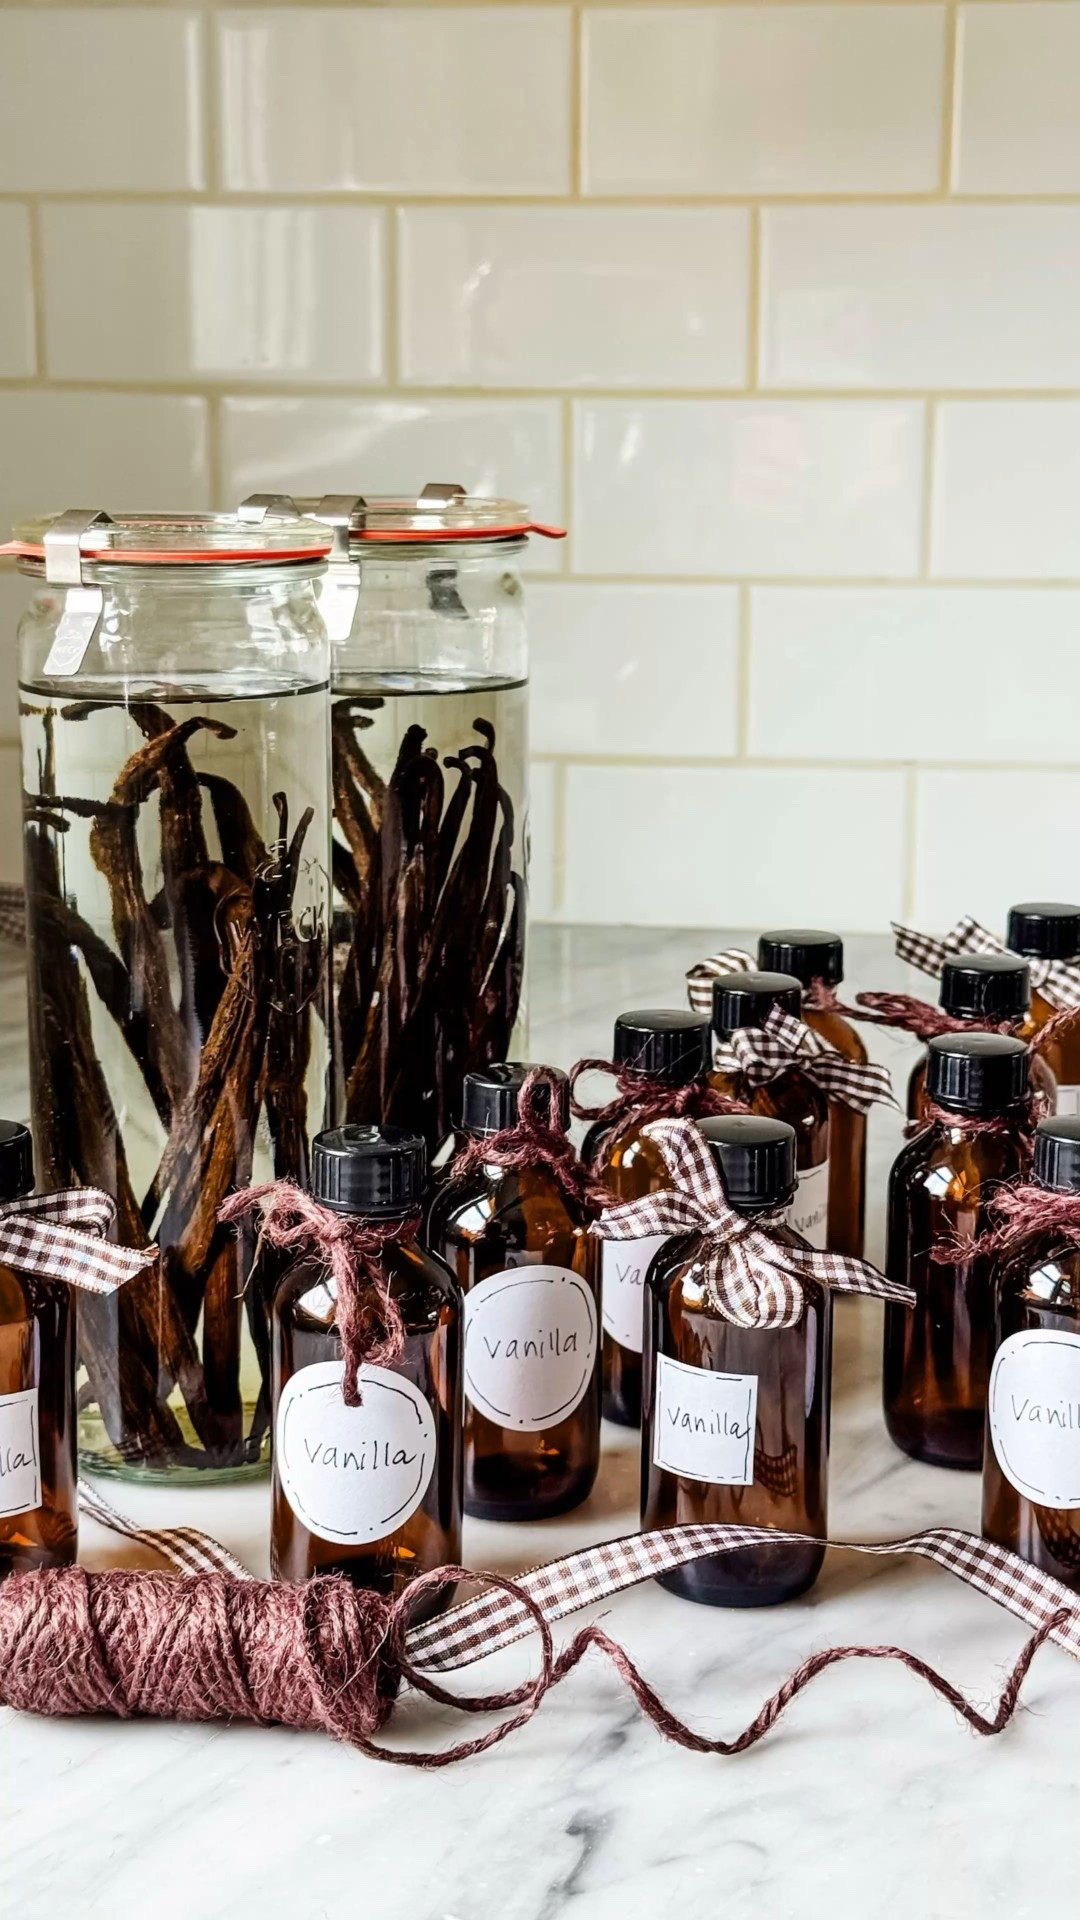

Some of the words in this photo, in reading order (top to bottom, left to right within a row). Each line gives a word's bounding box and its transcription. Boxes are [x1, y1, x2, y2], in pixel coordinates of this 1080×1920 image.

[483, 1327, 577, 1360] Vanilla
[668, 1406, 752, 1440] Vanilla
[304, 1438, 418, 1470] Vanilla
